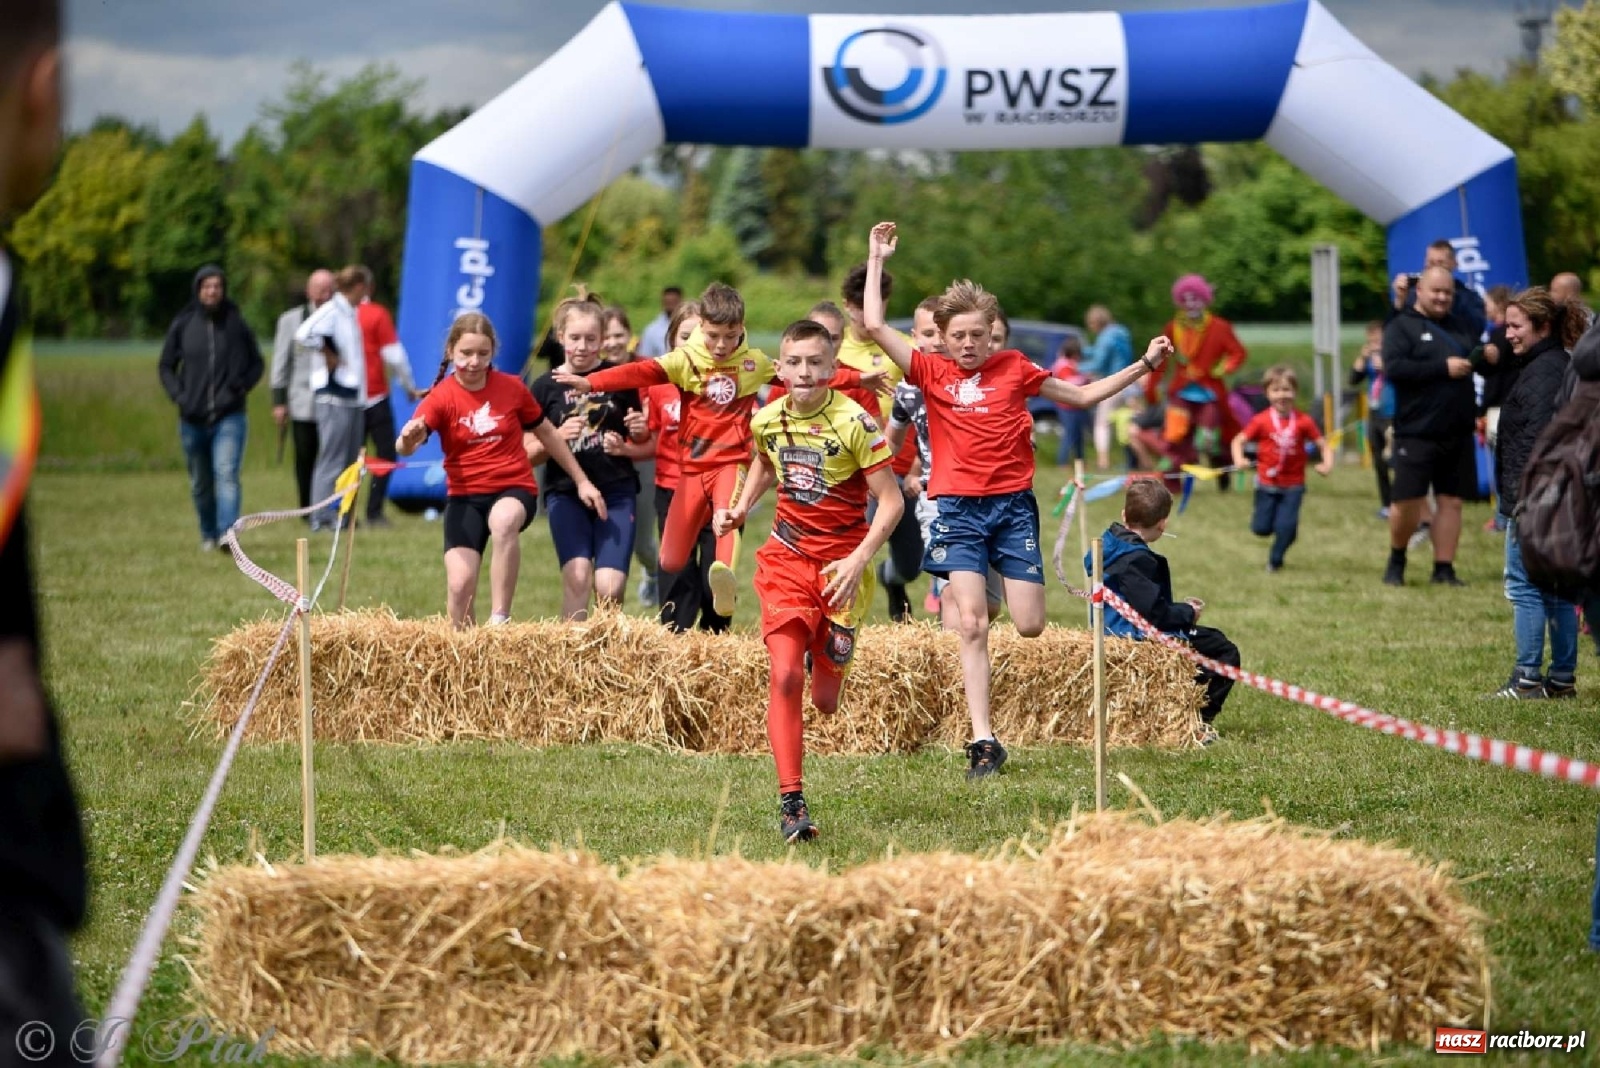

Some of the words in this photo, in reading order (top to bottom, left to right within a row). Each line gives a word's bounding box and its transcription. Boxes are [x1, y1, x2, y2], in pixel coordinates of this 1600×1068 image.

[965, 67, 1118, 109] PWSZ
[963, 112, 987, 125] W
[995, 109, 1118, 125] RACIBORZU
